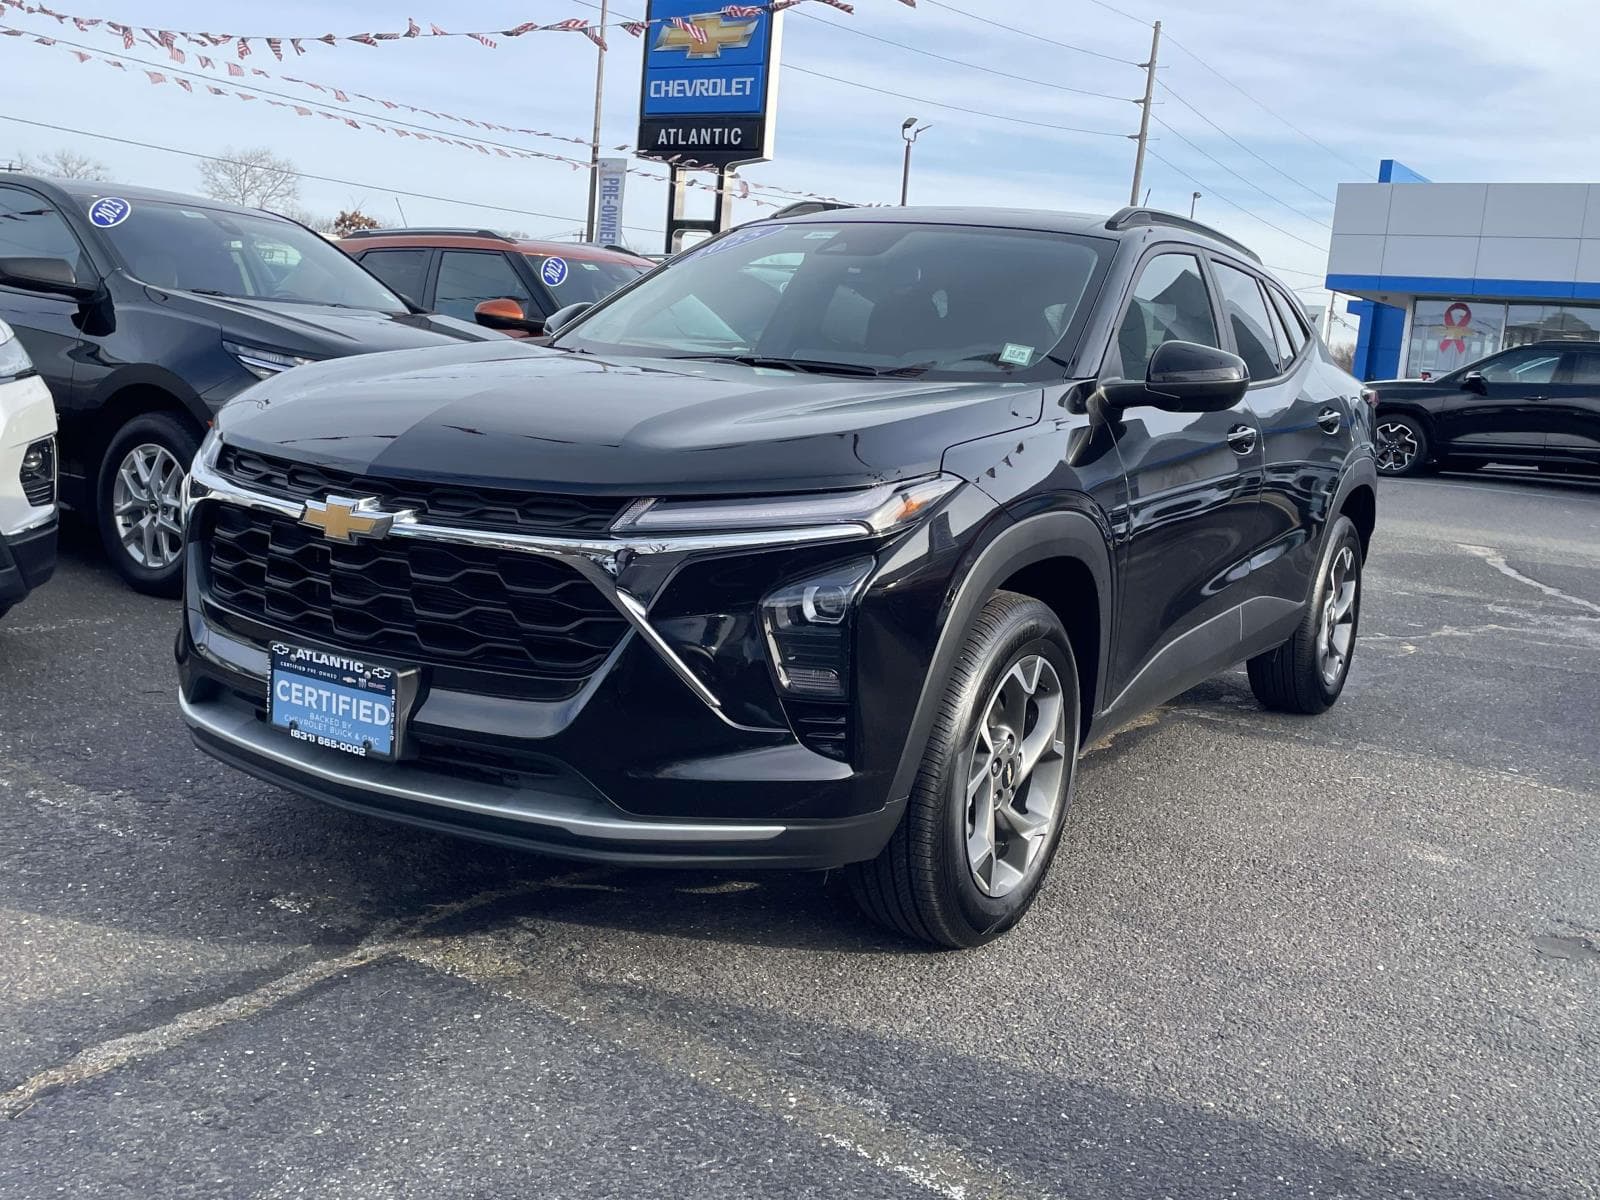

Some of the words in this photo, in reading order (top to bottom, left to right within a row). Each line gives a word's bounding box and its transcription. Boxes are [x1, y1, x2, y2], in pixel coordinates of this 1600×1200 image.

[650, 77, 755, 98] CHEVROLET
[657, 127, 742, 145] ATLANTIC
[95, 199, 124, 223] 2023
[544, 259, 563, 283] 2022
[280, 661, 306, 672] CERTIFIED
[296, 648, 364, 674] ATLANTIC
[276, 679, 391, 726] CERTIFIED
[284, 713, 327, 731] CHEVROLET
[329, 726, 353, 738] BUICK
[354, 732, 360, 740] &
[309, 712, 339, 727] BACKED
[341, 720, 352, 730] BY
[317, 736, 366, 757] 665-0002
